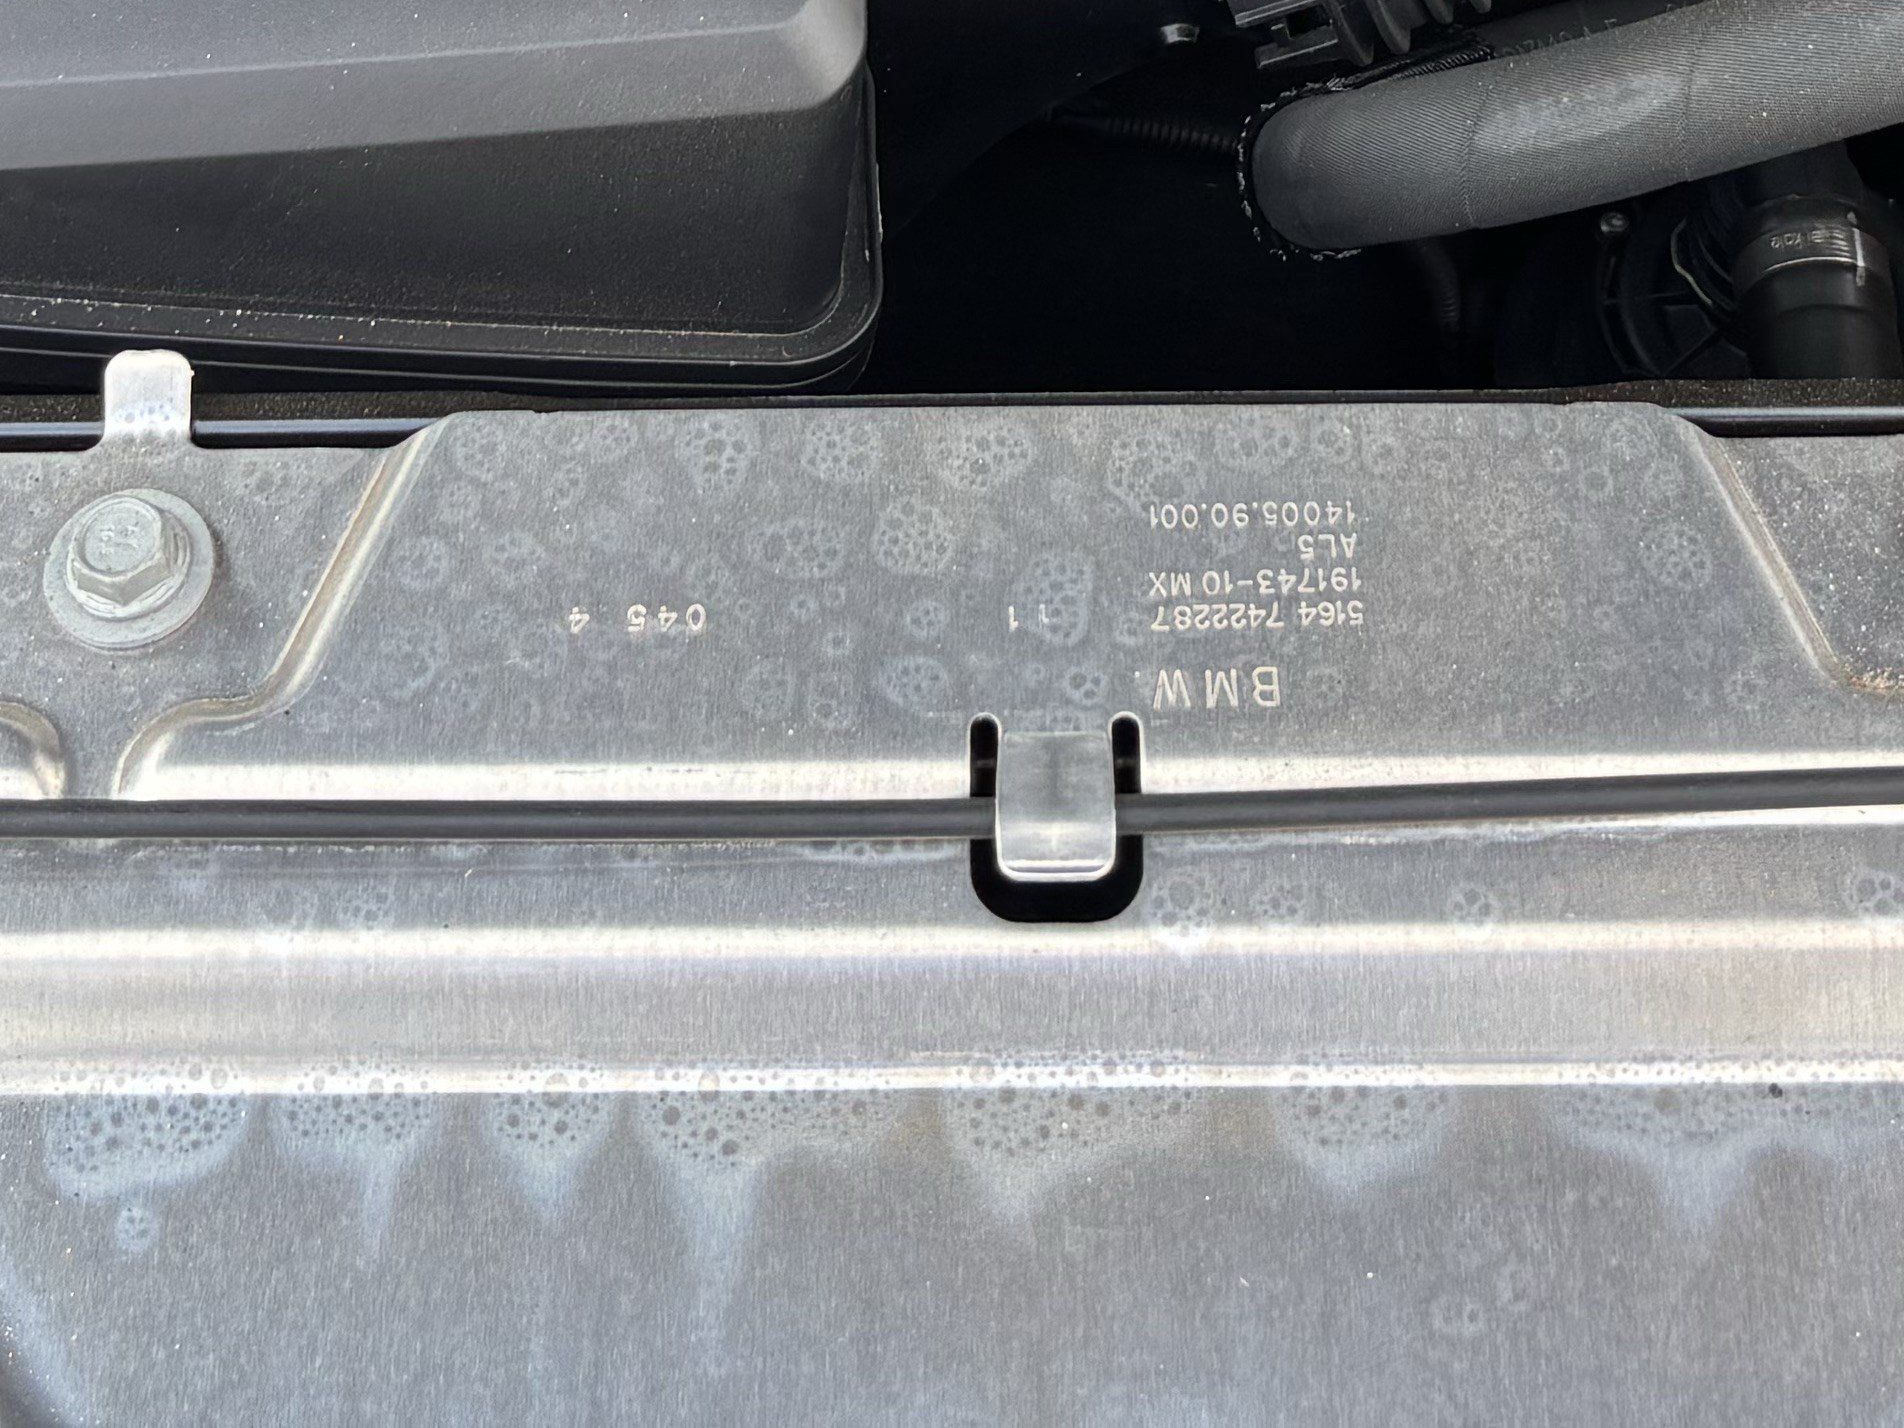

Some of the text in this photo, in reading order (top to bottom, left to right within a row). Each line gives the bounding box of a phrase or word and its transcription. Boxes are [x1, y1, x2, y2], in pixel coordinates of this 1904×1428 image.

[1150, 500, 1356, 530] 14005.90.001
[1298, 532, 1358, 560] AL5
[1148, 566, 1362, 598] 191743-10 MX
[626, 603, 707, 633] 045
[1150, 599, 1364, 633] 5164 7422287
[1152, 665, 1281, 712] BMW
